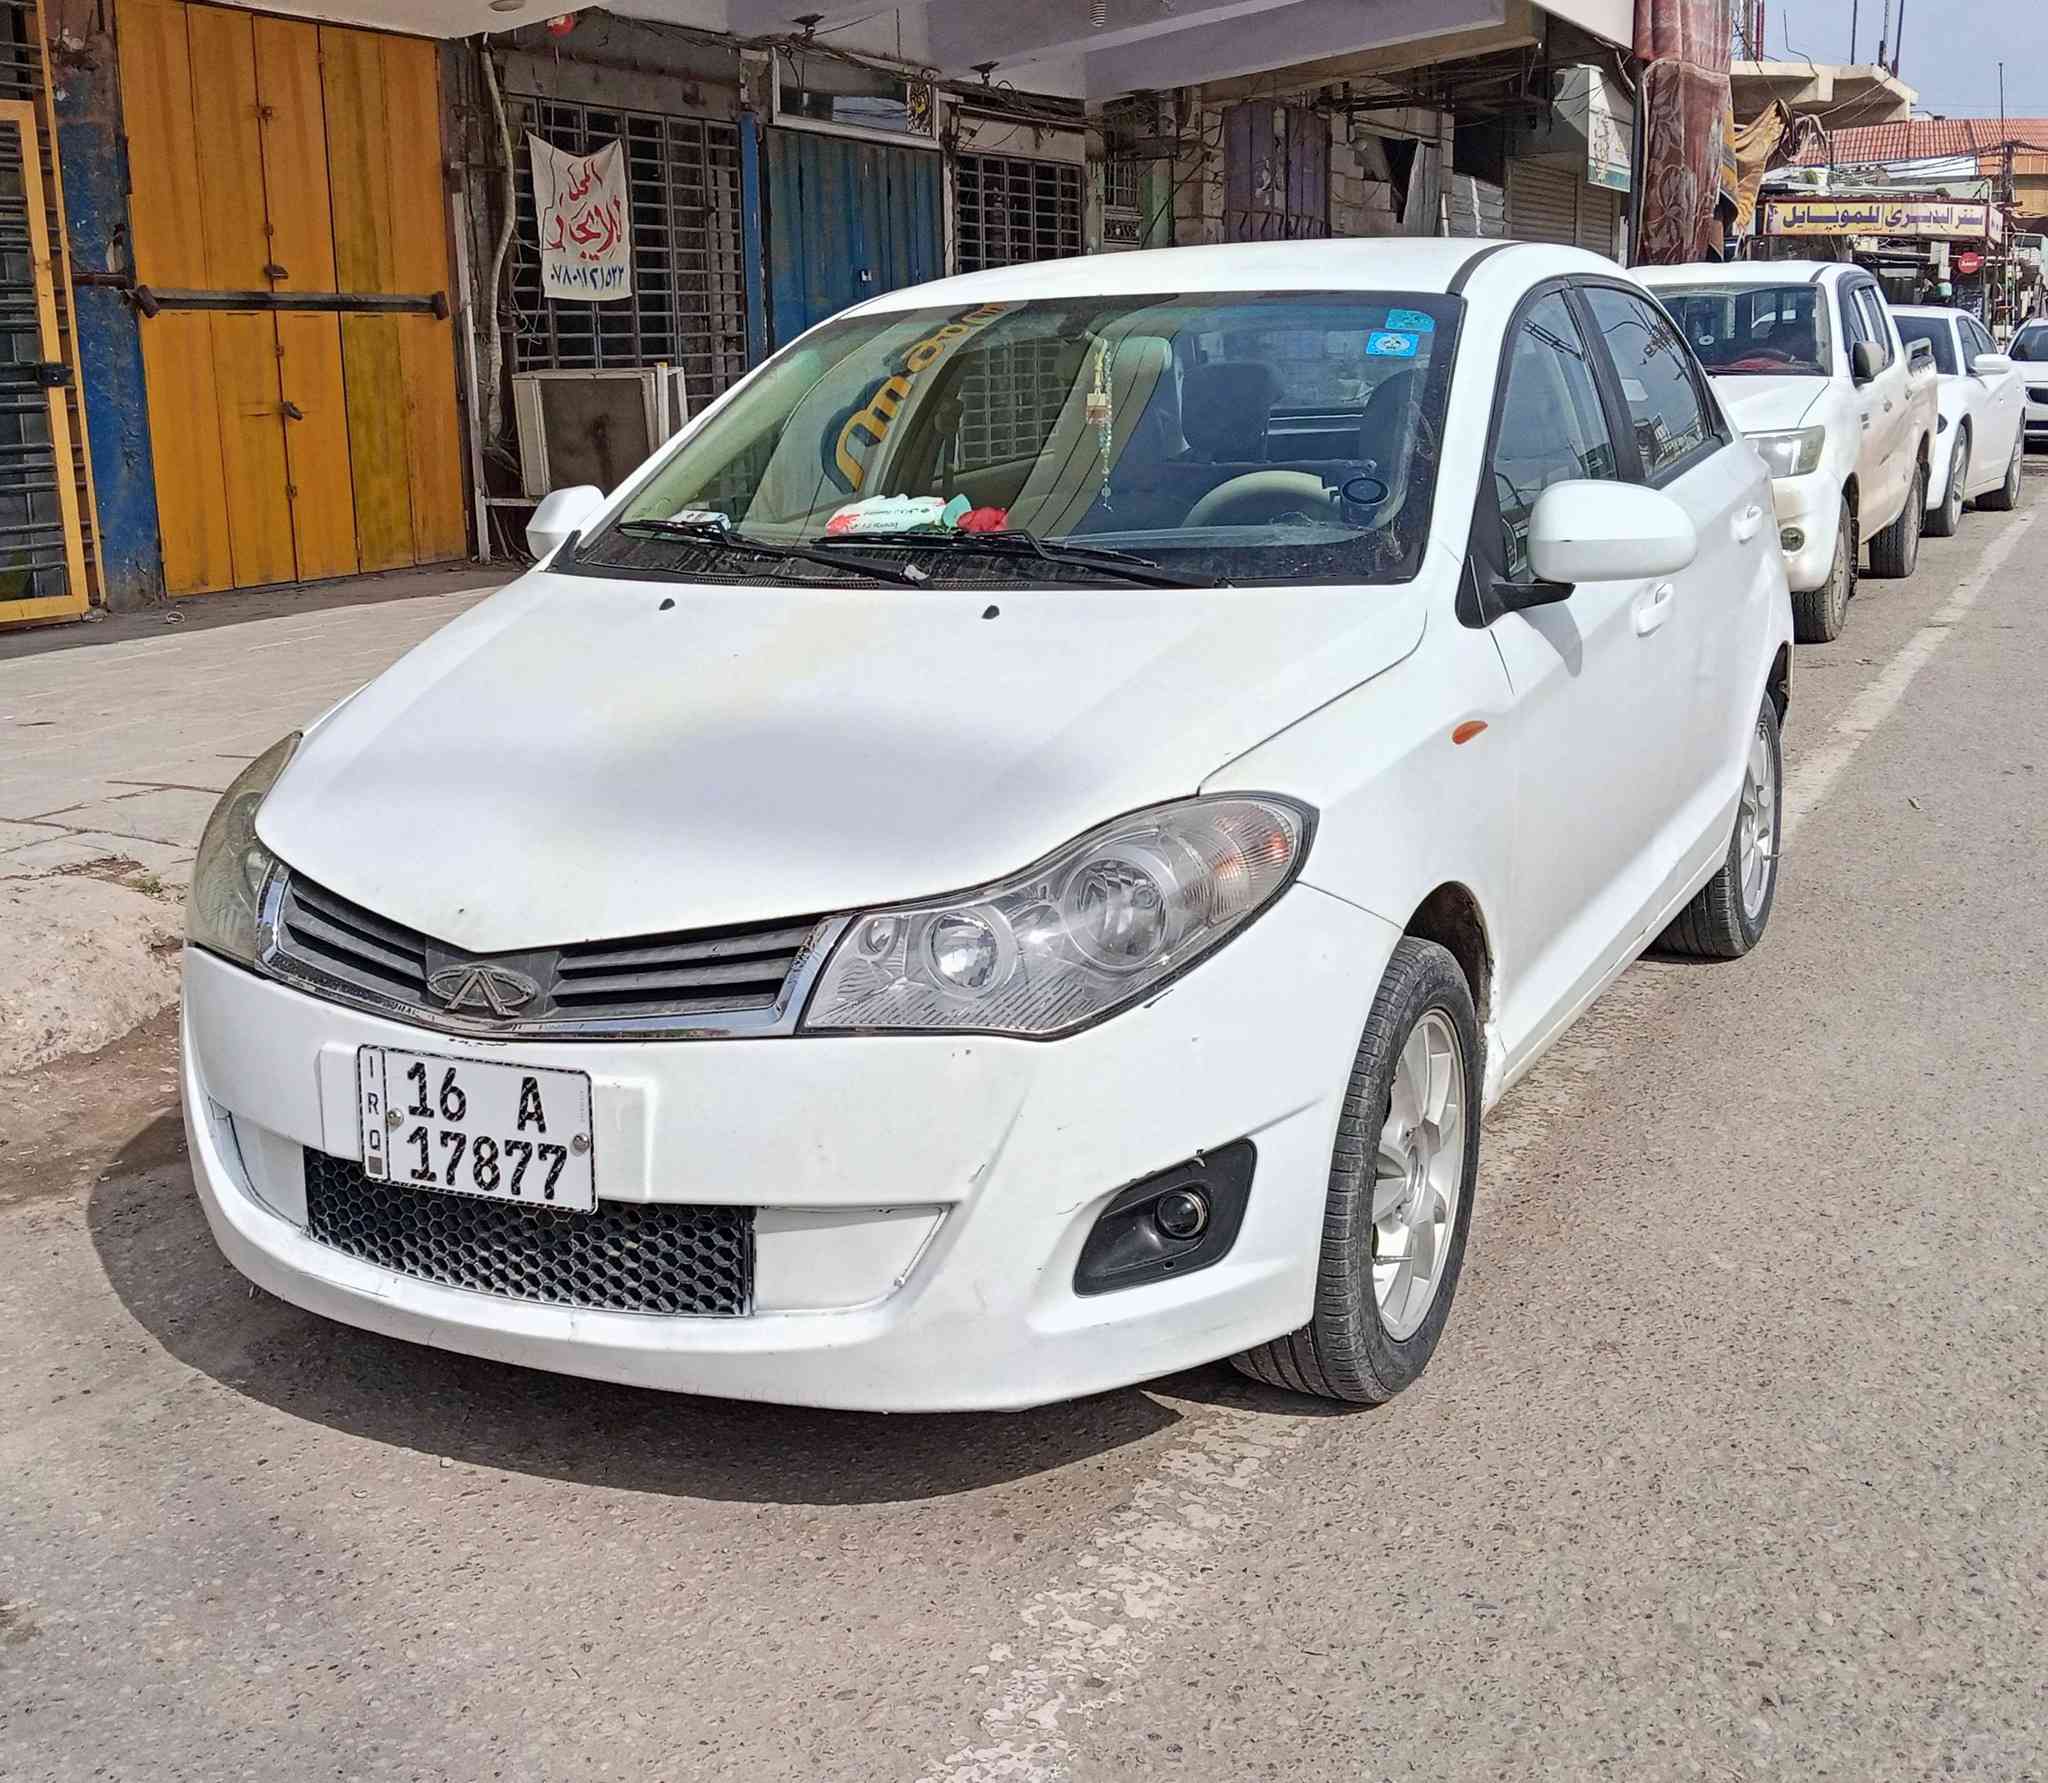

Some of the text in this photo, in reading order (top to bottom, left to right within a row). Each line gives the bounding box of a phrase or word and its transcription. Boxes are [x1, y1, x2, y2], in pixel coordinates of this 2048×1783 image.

[1783, 205, 1882, 232] للموبايل
[407, 1061, 467, 1122] 16
[516, 1076, 547, 1133] A
[407, 1125, 568, 1201] 17877
